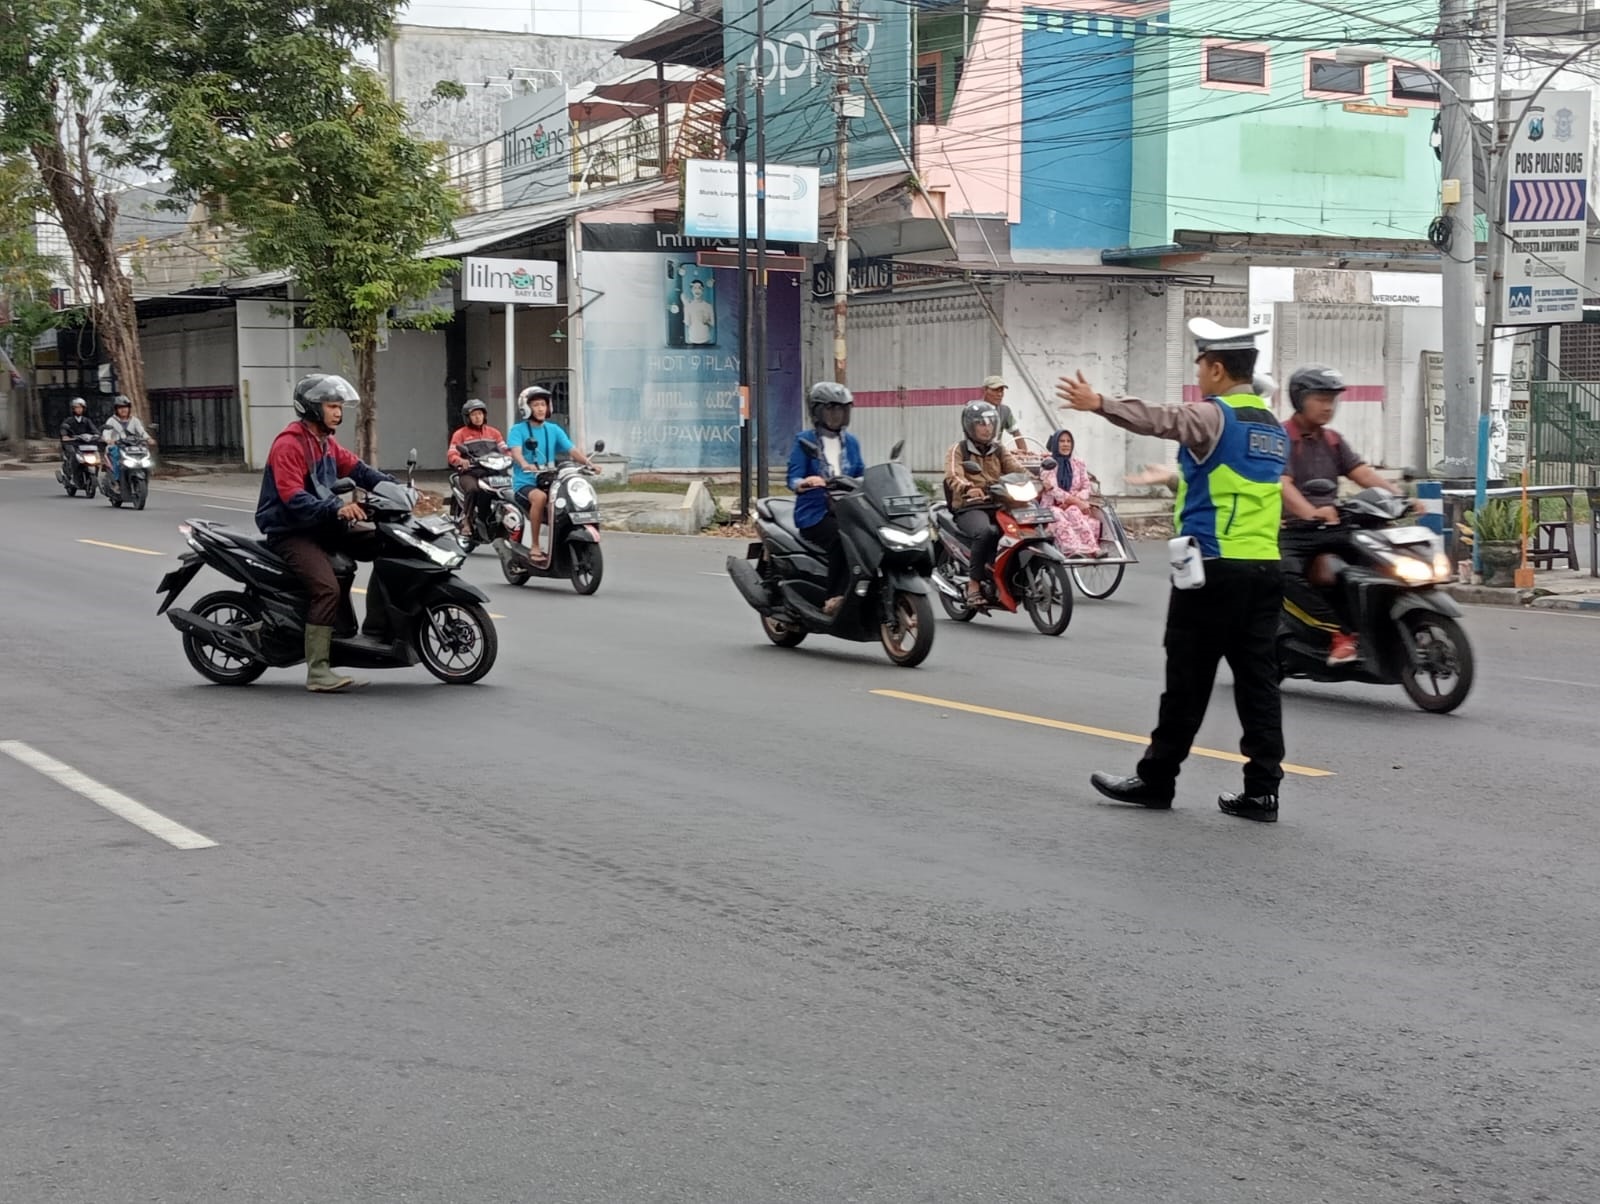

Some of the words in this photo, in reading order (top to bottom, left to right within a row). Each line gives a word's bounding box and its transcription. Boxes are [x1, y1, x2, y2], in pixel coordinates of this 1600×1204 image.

[1515, 152, 1533, 174] POS
[1535, 152, 1563, 174] POLISI
[1565, 152, 1583, 174] 905
[470, 263, 554, 291] lilmons
[817, 263, 888, 293] SASUNG
[648, 355, 685, 371] HOT
[690, 355, 700, 370] 9
[705, 355, 740, 371] PLAY
